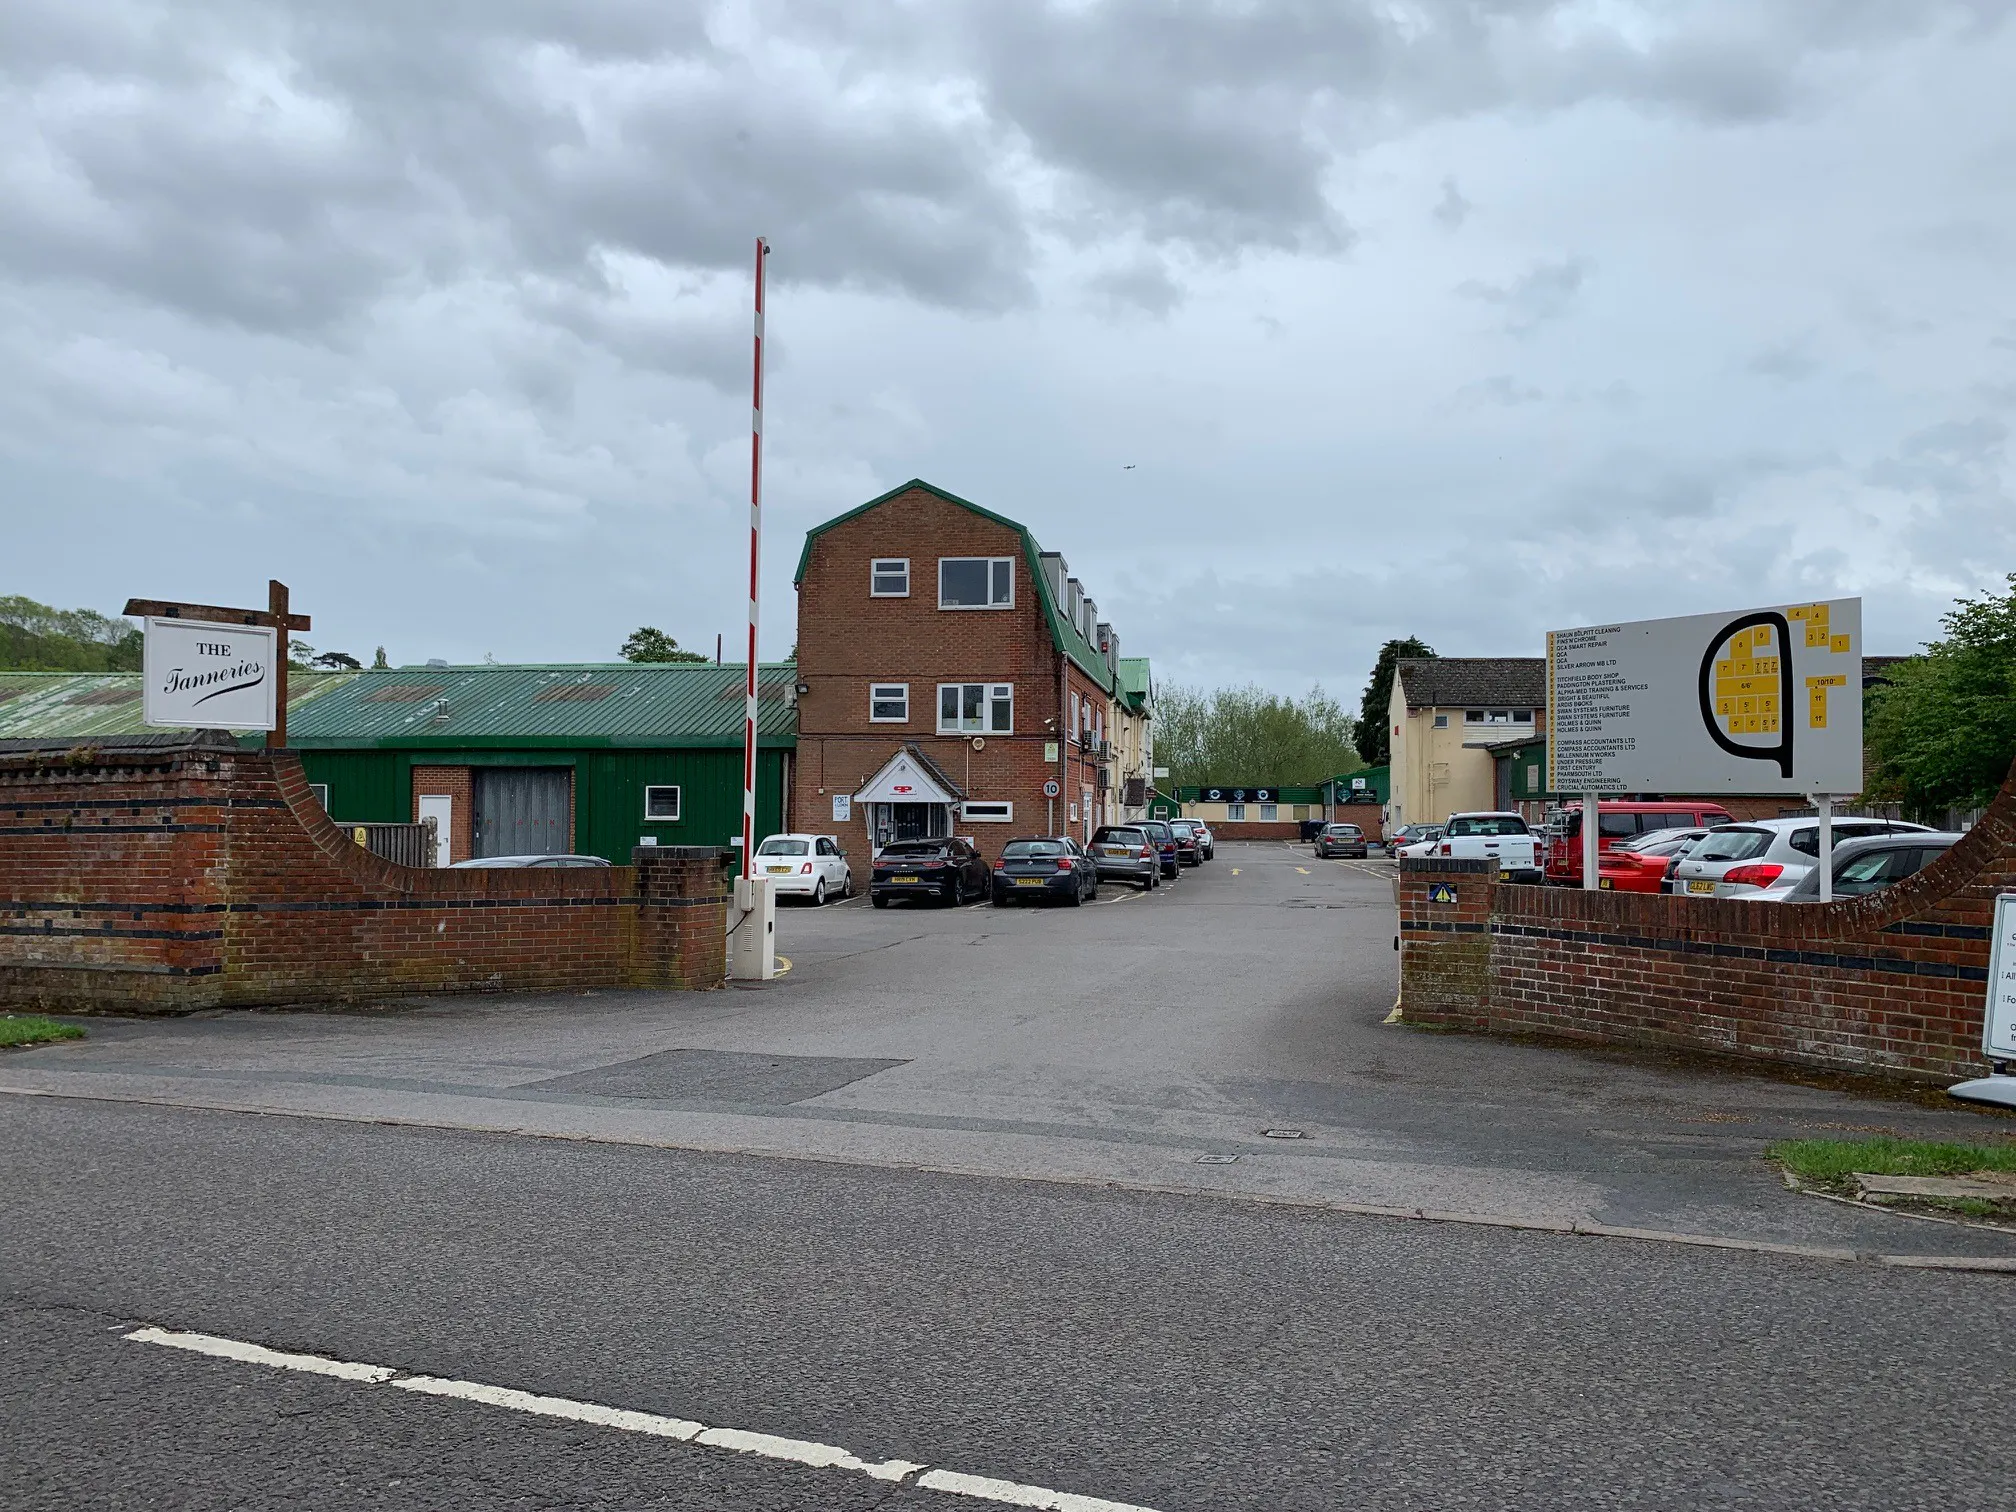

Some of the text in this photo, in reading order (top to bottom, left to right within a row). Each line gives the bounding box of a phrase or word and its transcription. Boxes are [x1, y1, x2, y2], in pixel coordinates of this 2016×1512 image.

[196, 642, 231, 656] THE
[163, 660, 265, 696] Tanneries
[1046, 784, 1057, 794] 10
